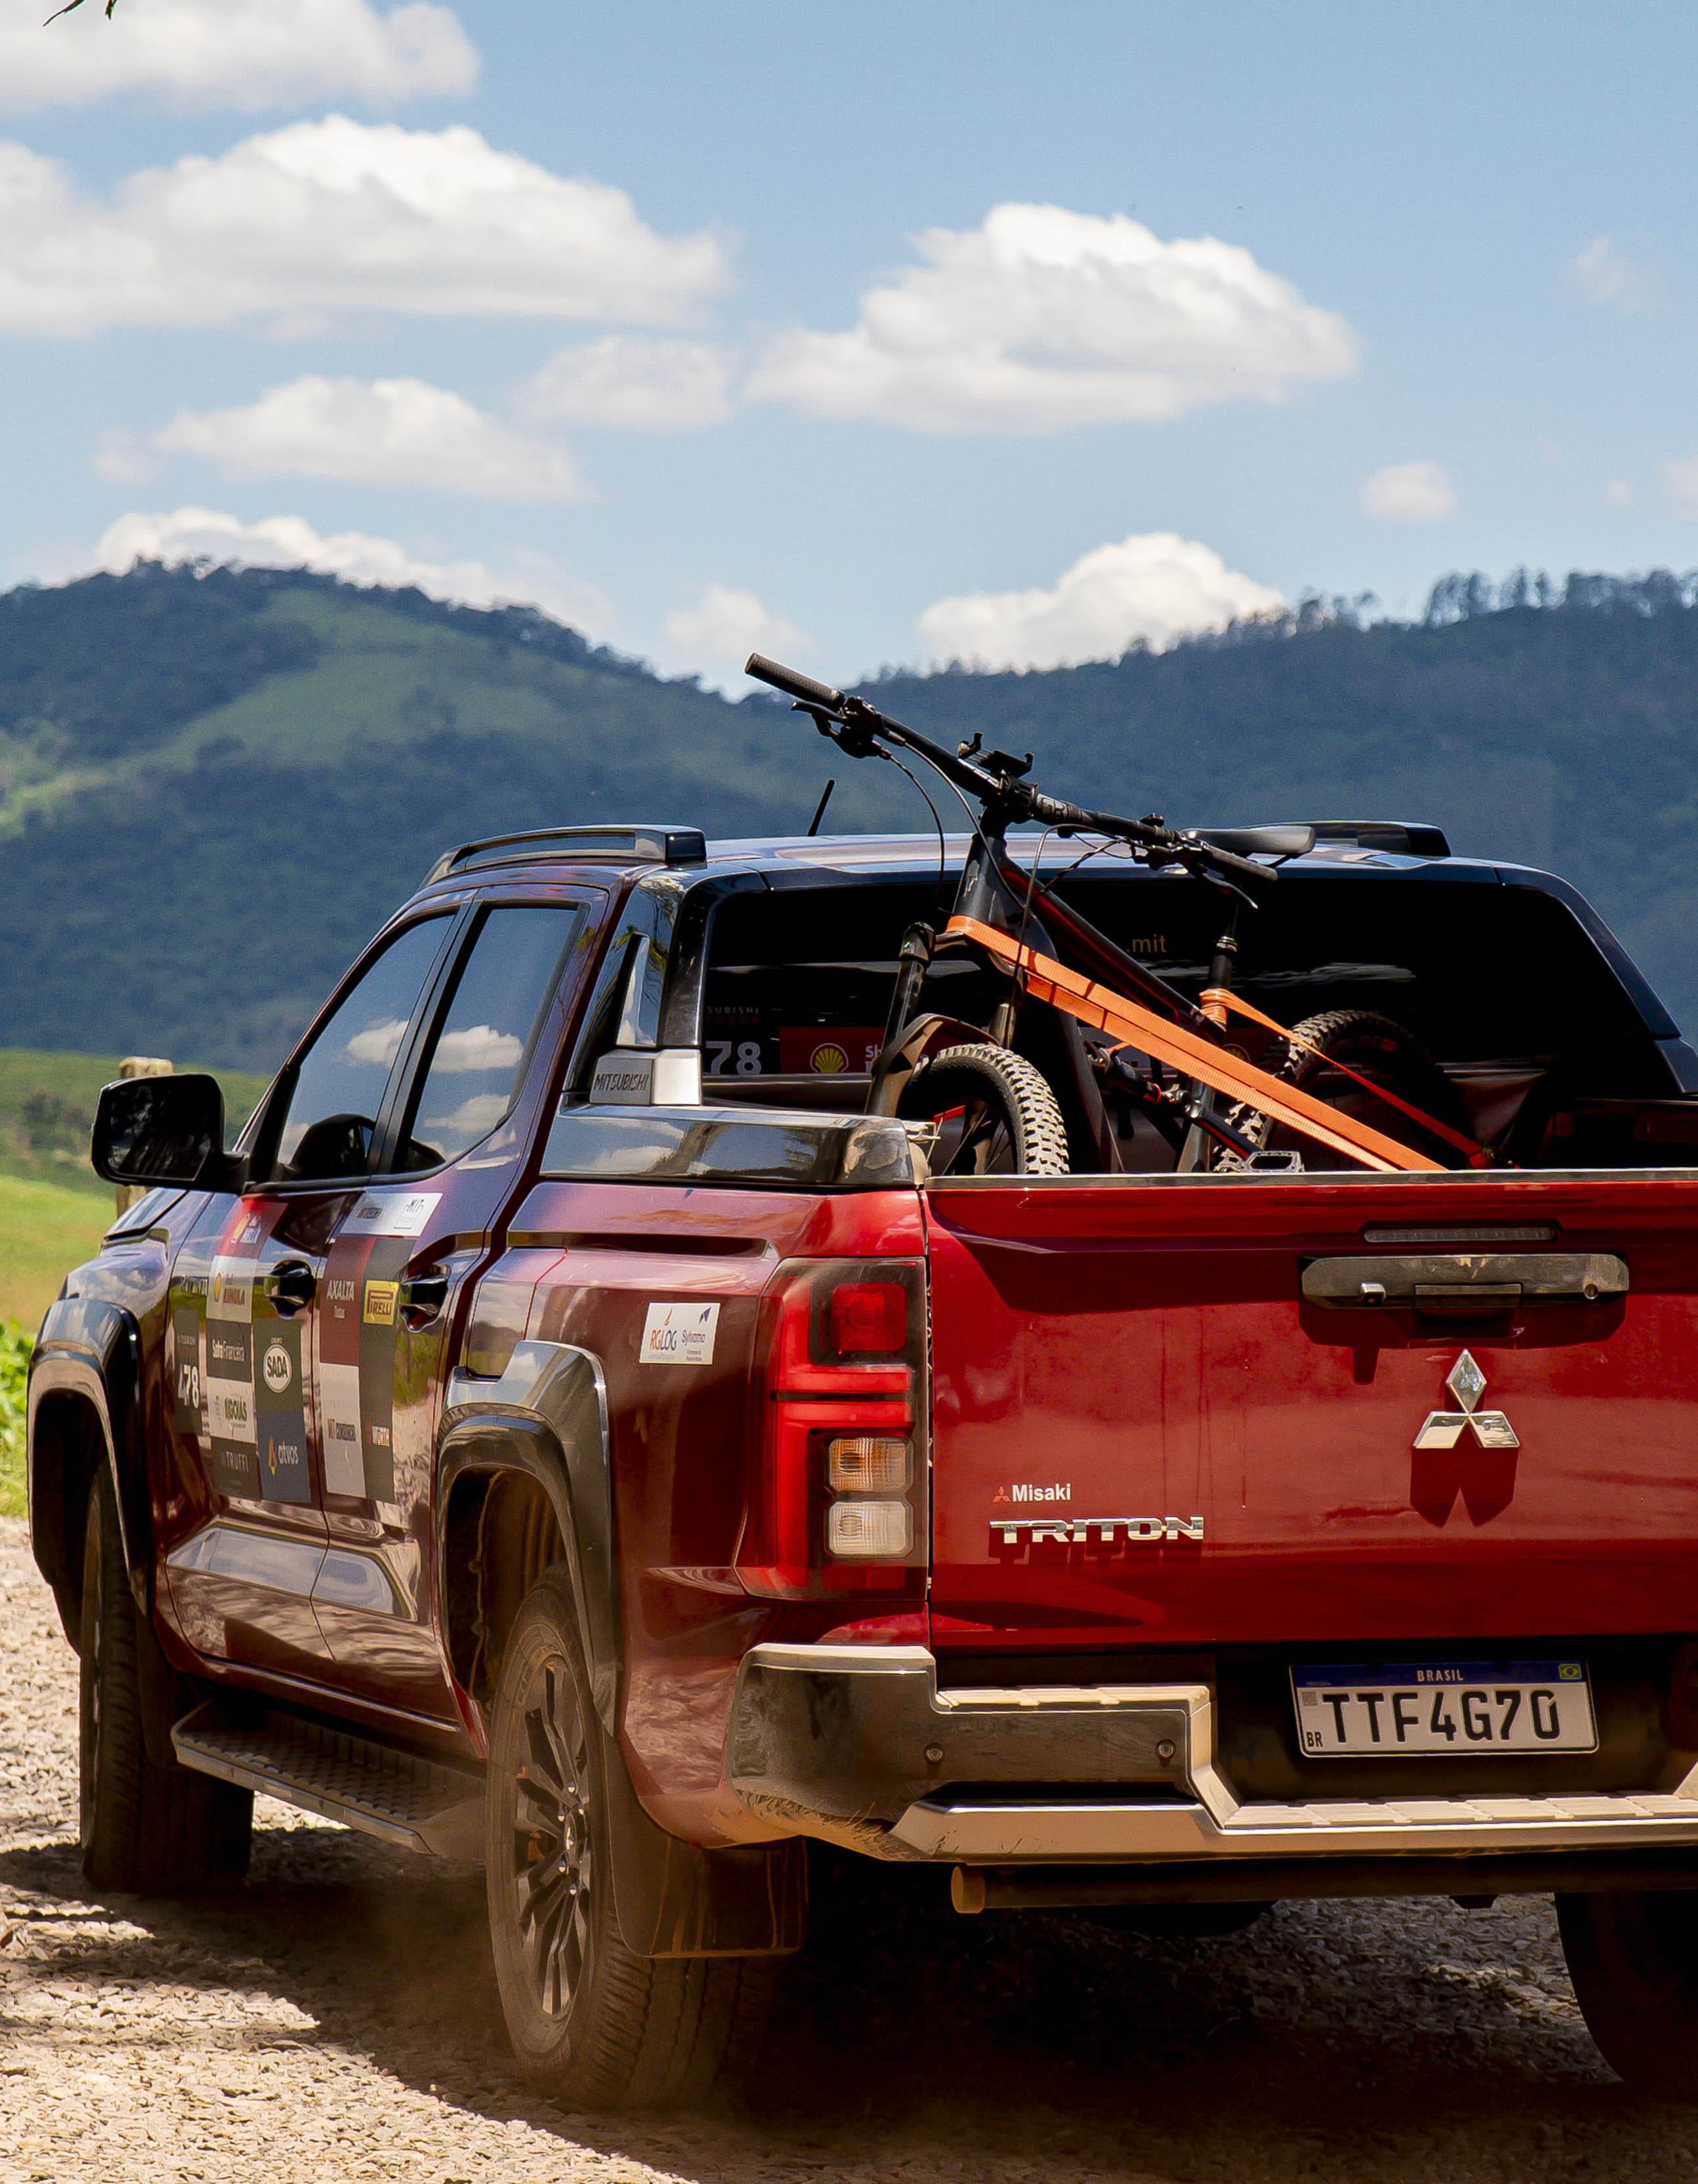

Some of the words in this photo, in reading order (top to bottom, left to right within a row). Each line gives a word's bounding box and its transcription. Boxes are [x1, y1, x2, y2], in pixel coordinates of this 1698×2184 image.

[594, 1074, 649, 1092] MITSUBISHI
[326, 1280, 355, 1301] AXALTA
[267, 1356, 288, 1378] SADA
[1012, 1483, 1071, 1503] Misaki
[989, 1516, 1205, 1544] TRITON
[1416, 1669, 1463, 1682] BRASIL
[1322, 1690, 1561, 1743] TTF4G70
[1306, 1731, 1323, 1748] BR
